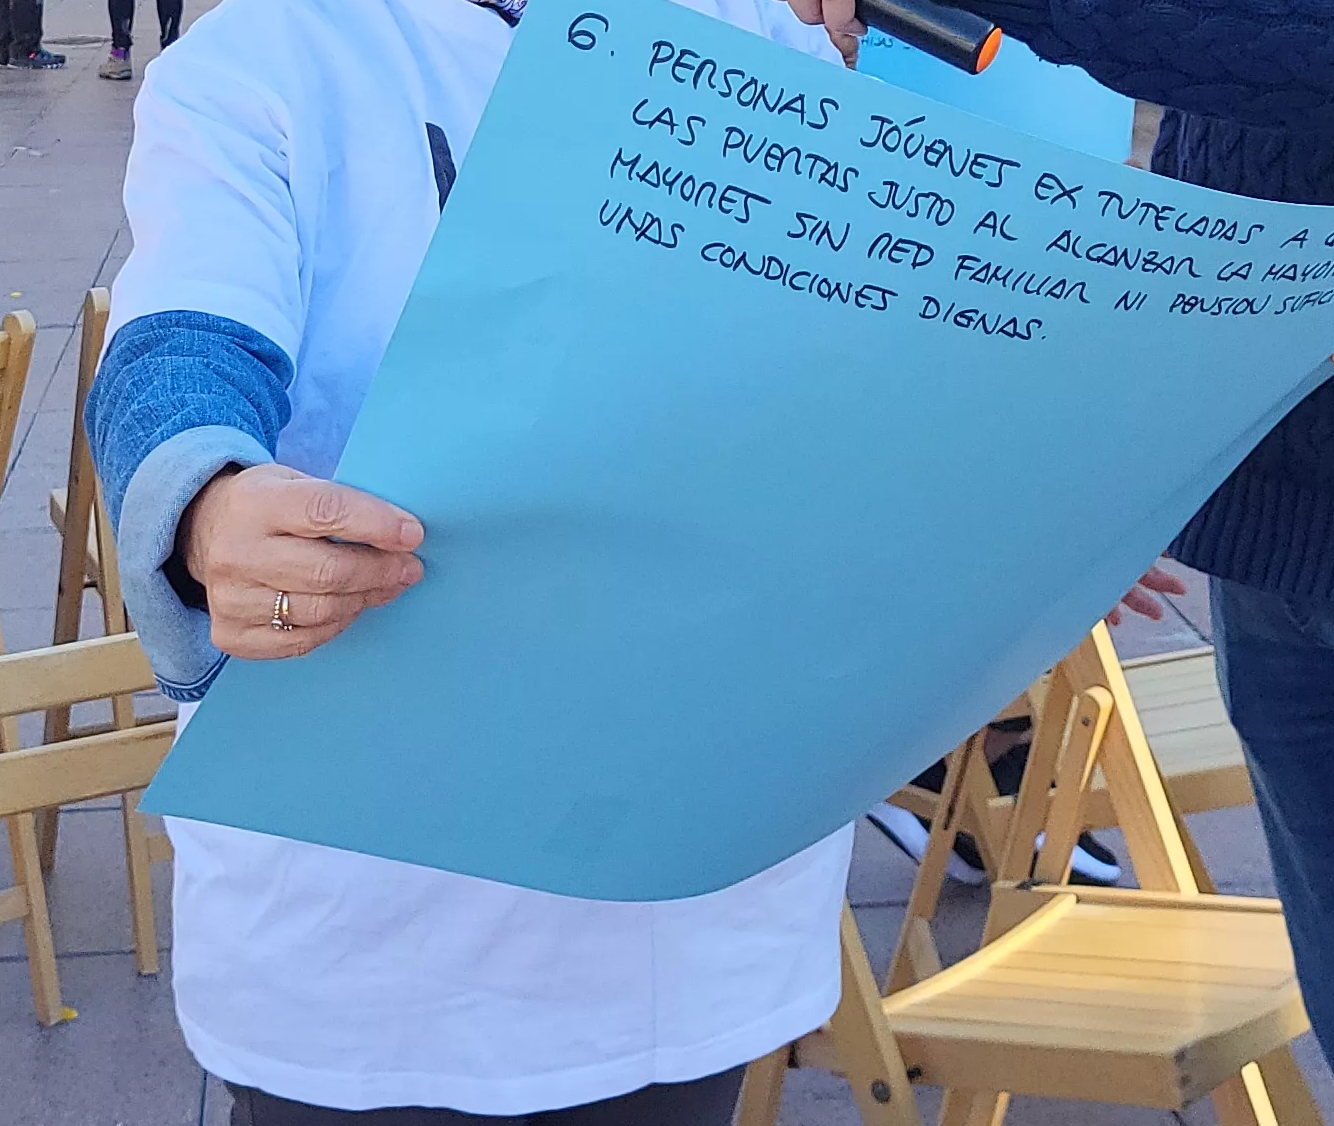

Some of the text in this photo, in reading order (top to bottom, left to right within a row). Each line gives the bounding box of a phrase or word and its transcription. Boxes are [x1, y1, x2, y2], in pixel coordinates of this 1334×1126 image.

[609, 147, 772, 225] MAYORES
[787, 211, 851, 253] SIN
[867, 231, 935, 271] RED
[953, 253, 1091, 305] FAMILIAR
[1114, 288, 1148, 313] NI
[631, 98, 706, 147] LAS
[723, 126, 859, 194] PUERTAS
[868, 179, 955, 227] JUSTO
[973, 210, 1019, 243] AL
[1046, 228, 1201, 279] ALCANZAR
[1217, 260, 1254, 283] LA
[648, 40, 840, 131] PERSONAS
[859, 115, 1022, 188] JÓVENES
[1034, 172, 1085, 210] EX
[1097, 189, 1265, 246] TUTELADAS
[1279, 228, 1311, 250] A
[598, 198, 1048, 343] UNAS CONDICIONES DIGNAS.
